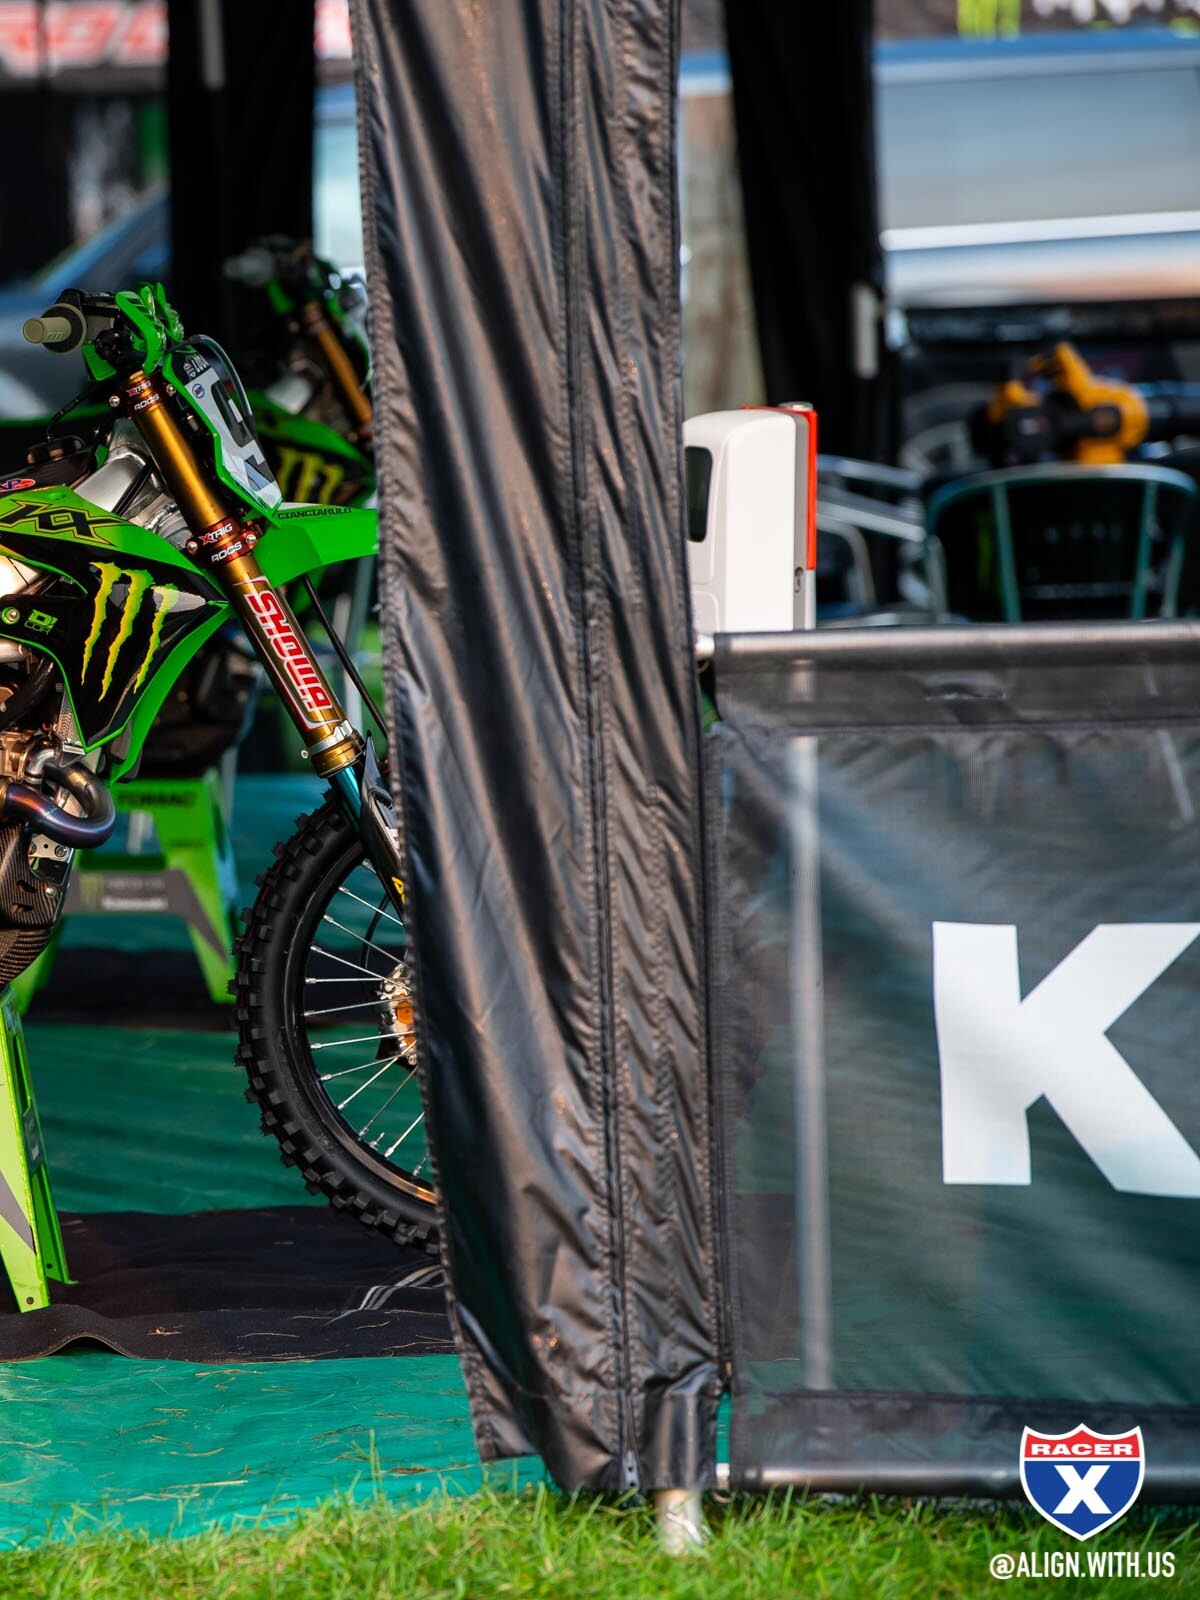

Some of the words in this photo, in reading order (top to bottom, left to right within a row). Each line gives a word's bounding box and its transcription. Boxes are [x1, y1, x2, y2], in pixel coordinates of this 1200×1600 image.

[134, 394, 160, 411] ROCS
[278, 507, 352, 520] CIANCIARULO
[198, 523, 233, 546] XTRIG
[211, 541, 243, 562] ROCS
[243, 590, 333, 713] SHOWA
[932, 921, 1200, 1198] K
